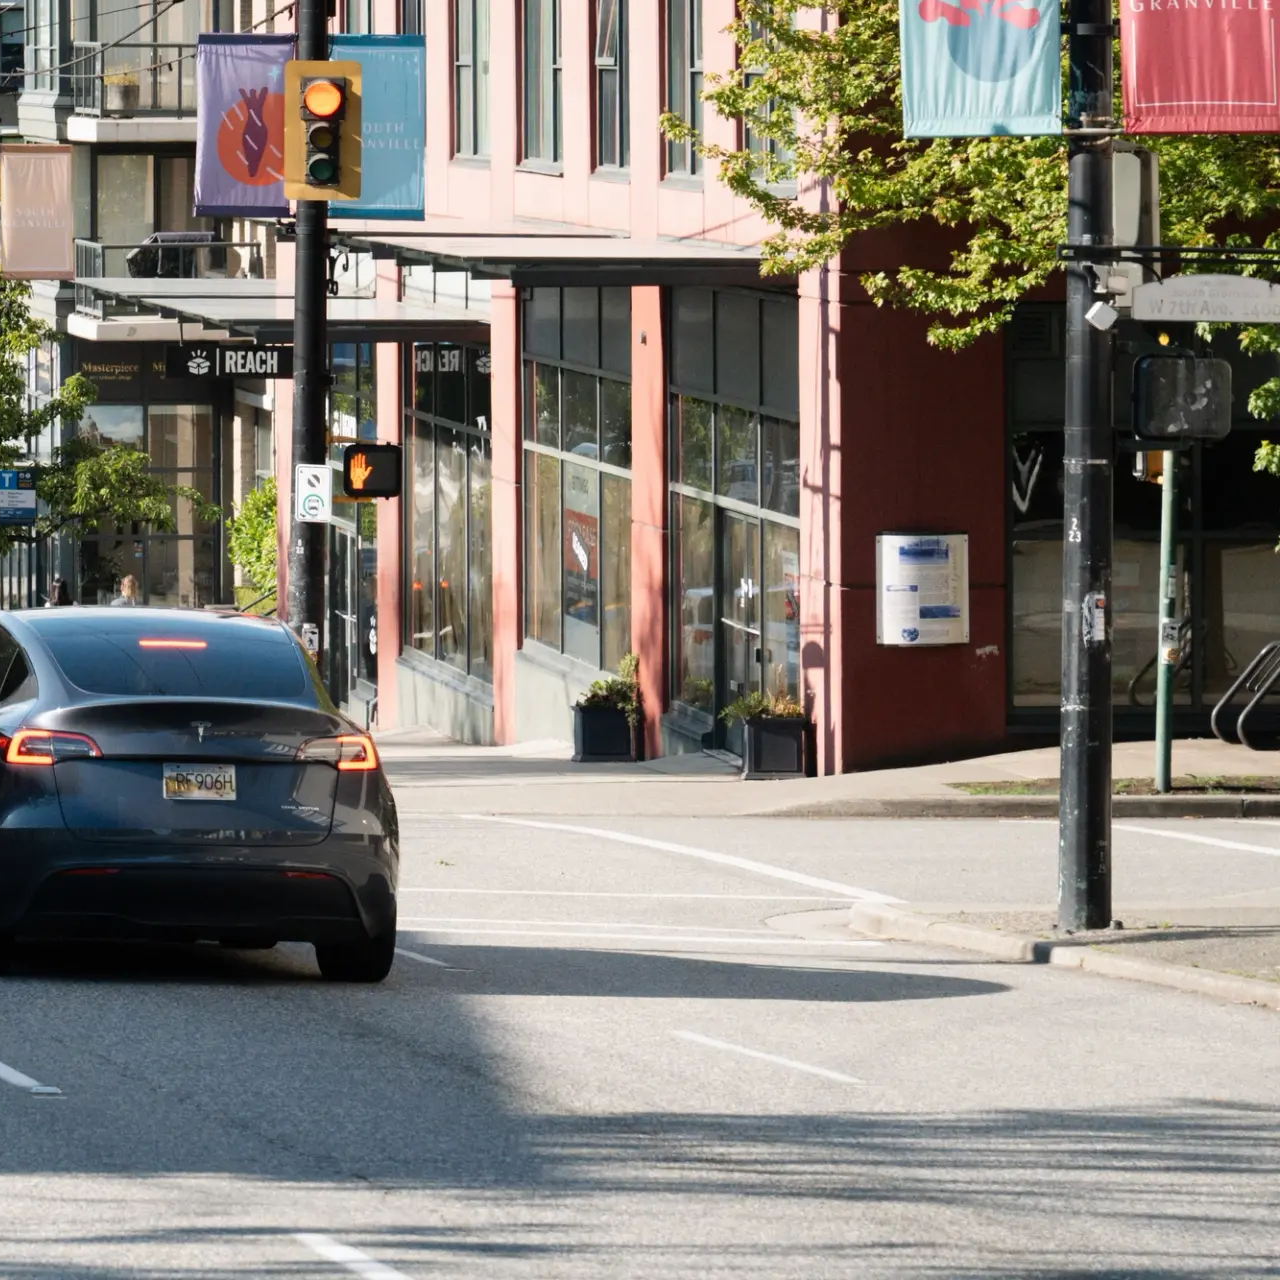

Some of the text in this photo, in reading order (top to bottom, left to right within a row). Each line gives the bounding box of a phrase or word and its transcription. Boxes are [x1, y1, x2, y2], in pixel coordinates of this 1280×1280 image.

[363, 121, 404, 134] OUTH
[81, 362, 140, 375] Masterpiece
[225, 351, 278, 374] REACH
